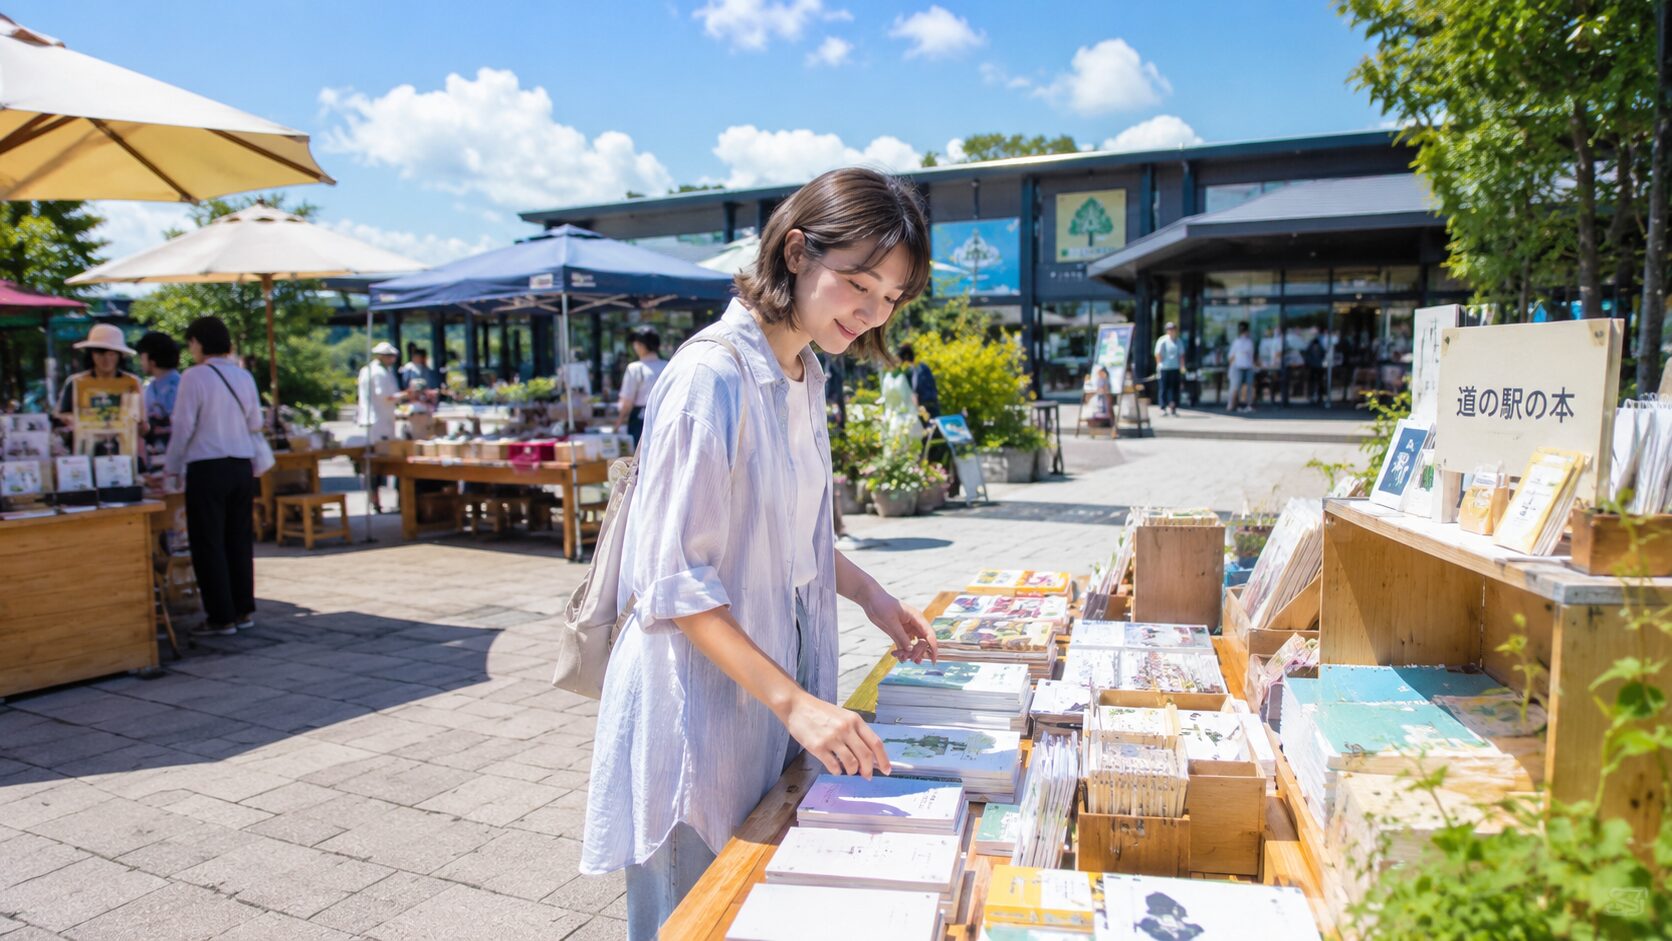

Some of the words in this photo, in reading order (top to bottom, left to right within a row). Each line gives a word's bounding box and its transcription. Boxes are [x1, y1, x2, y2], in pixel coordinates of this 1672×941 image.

[1456, 385, 1575, 423] 道の駅の本
